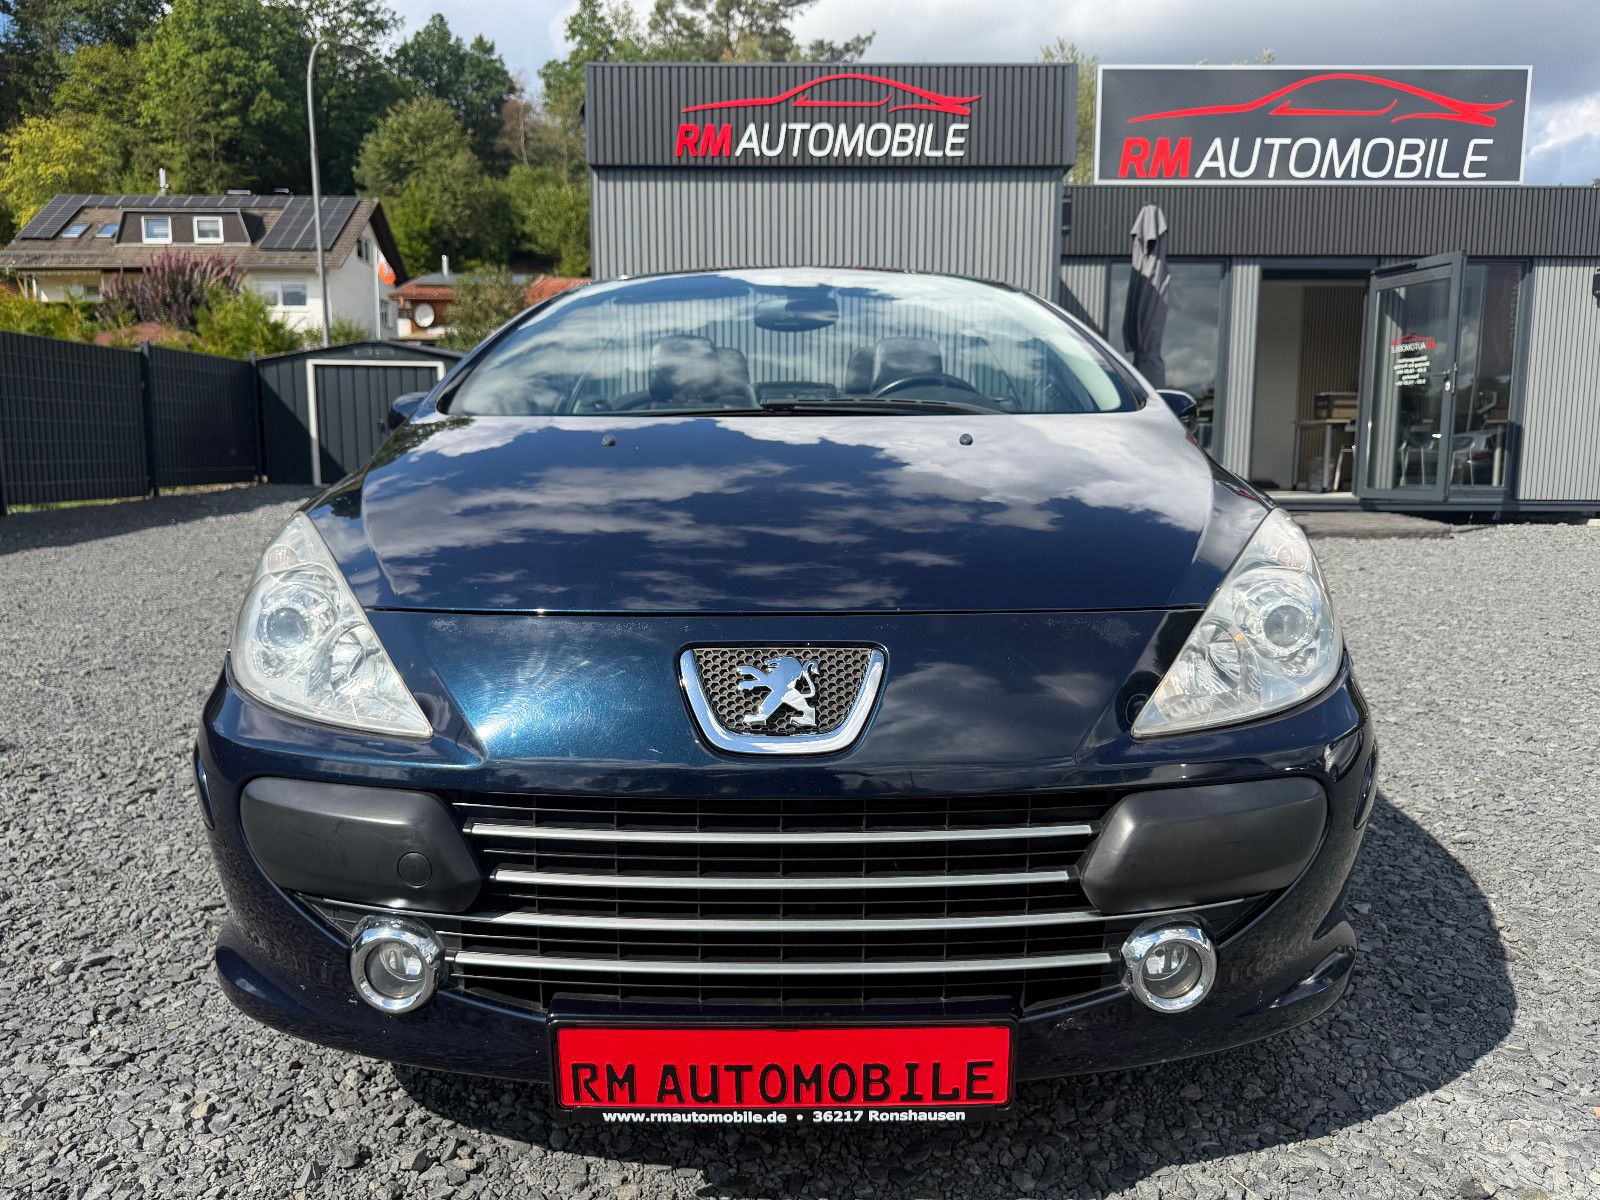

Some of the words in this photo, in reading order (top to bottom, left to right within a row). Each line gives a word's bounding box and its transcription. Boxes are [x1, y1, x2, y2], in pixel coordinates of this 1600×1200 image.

[674, 122, 733, 157] RM
[734, 122, 971, 157] AUTOMOBILE
[1117, 136, 1193, 178] RM
[1194, 137, 1494, 178] AUTOMOBILE
[571, 1062, 637, 1102] RM
[656, 1061, 995, 1103] AUTOMOBILE
[602, 1109, 788, 1123] www.rmautomobile.de
[812, 1109, 864, 1123] 36217
[868, 1109, 966, 1122] Ronshausen
